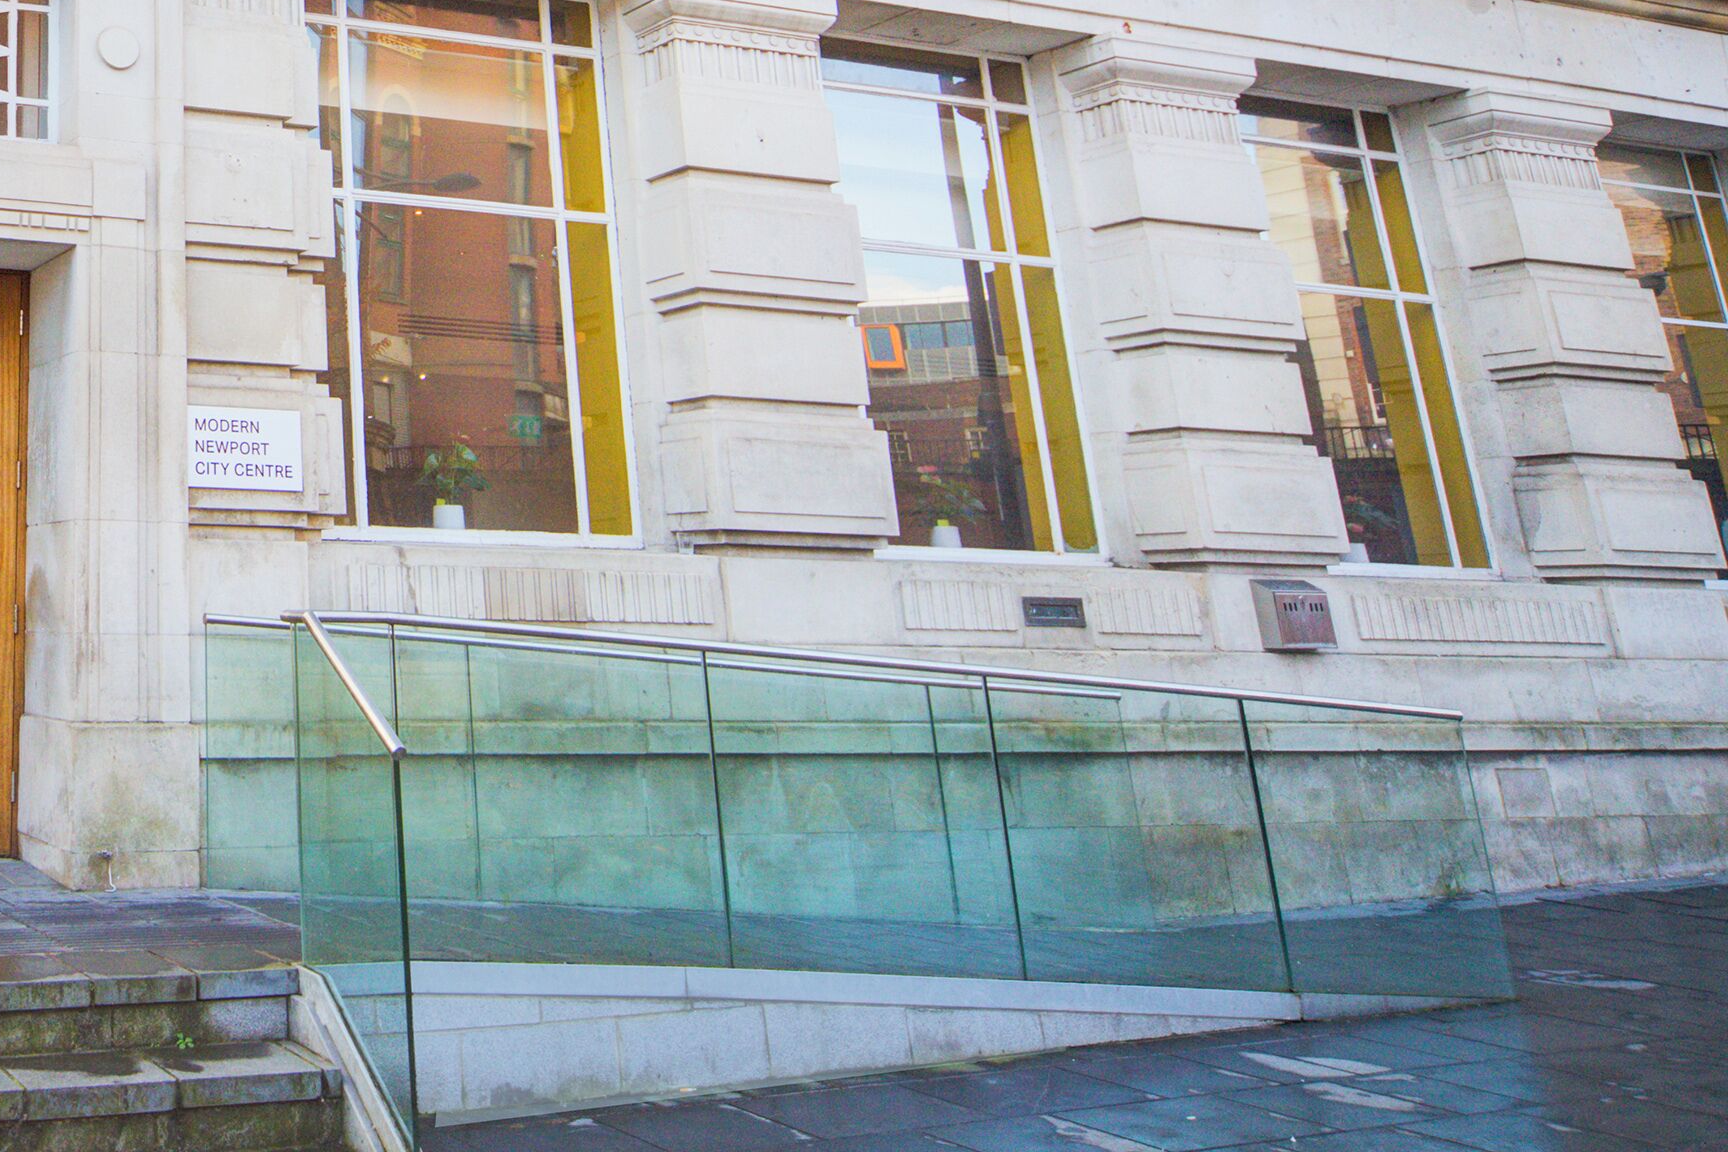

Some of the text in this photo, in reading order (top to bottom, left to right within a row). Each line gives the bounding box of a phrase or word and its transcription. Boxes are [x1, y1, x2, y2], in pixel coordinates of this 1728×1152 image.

[194, 418, 260, 434] MODERN
[195, 439, 269, 456] NEWPORT
[195, 461, 293, 479] CITY CENTRE
